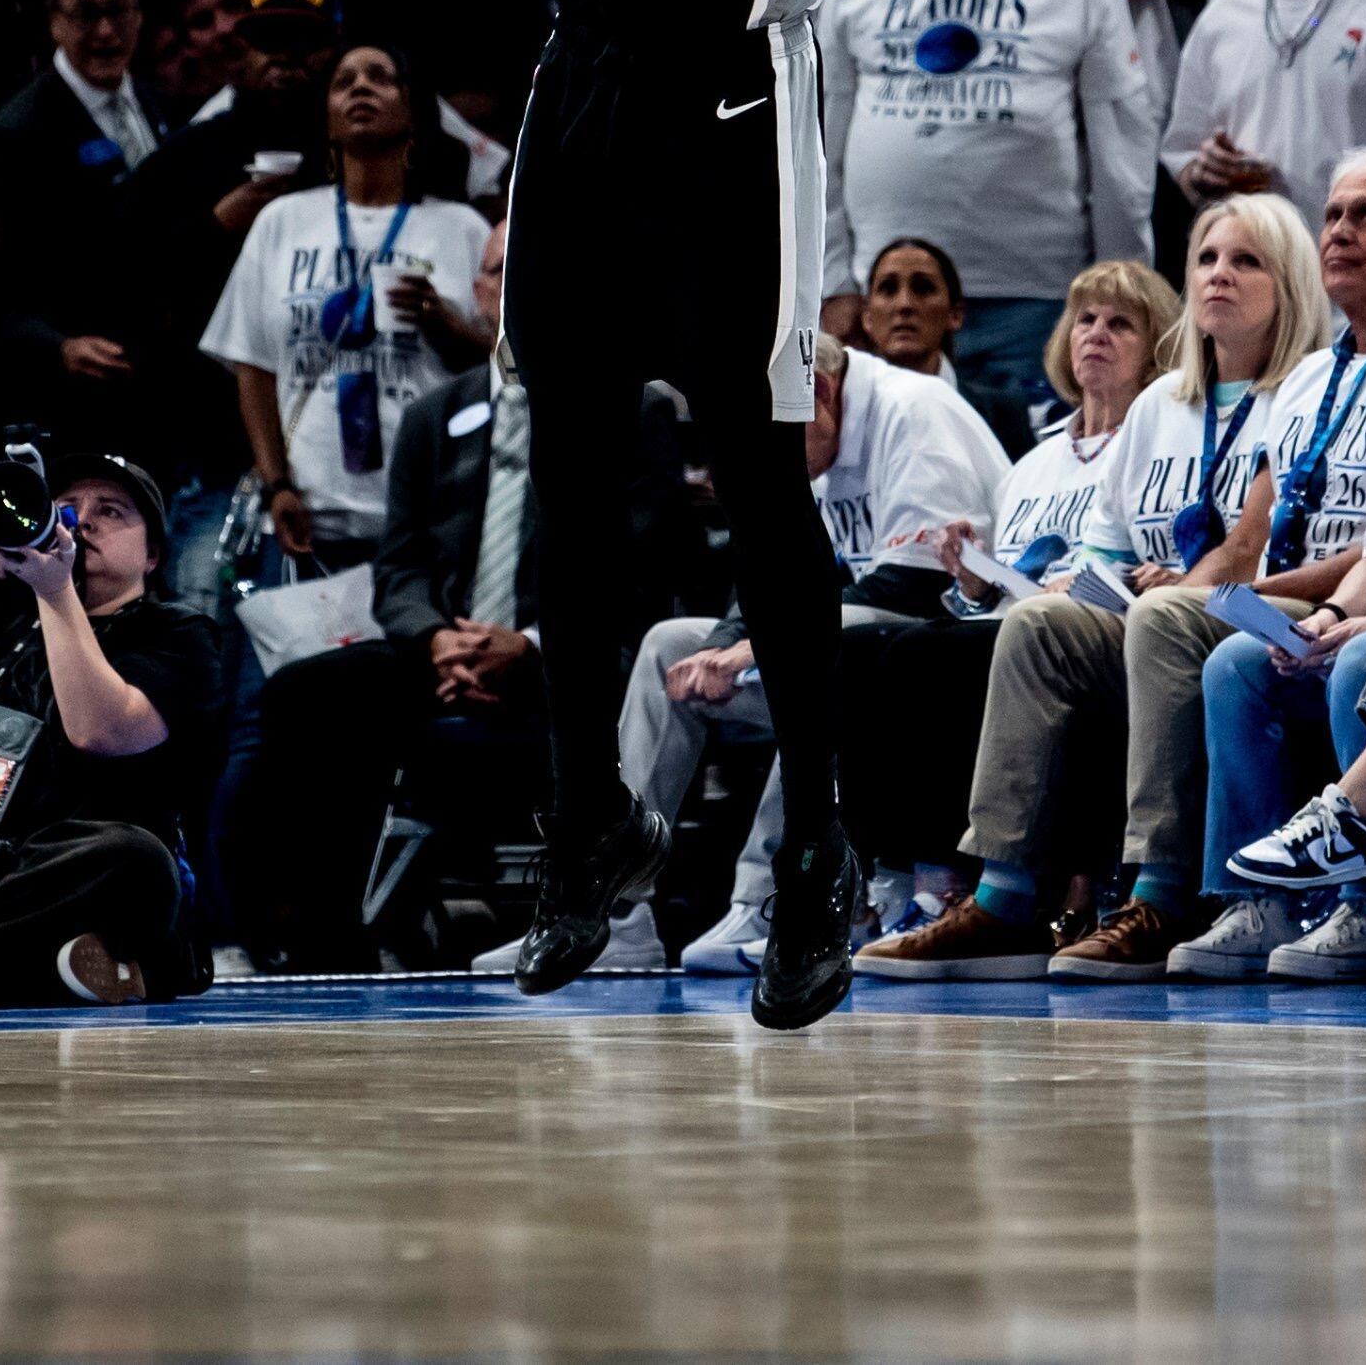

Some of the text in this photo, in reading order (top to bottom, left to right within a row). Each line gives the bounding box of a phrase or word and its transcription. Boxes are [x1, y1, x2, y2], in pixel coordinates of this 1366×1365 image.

[1334, 473, 1366, 508] 26
[1141, 528, 1168, 562] 20
[1312, 519, 1362, 545] CITY
